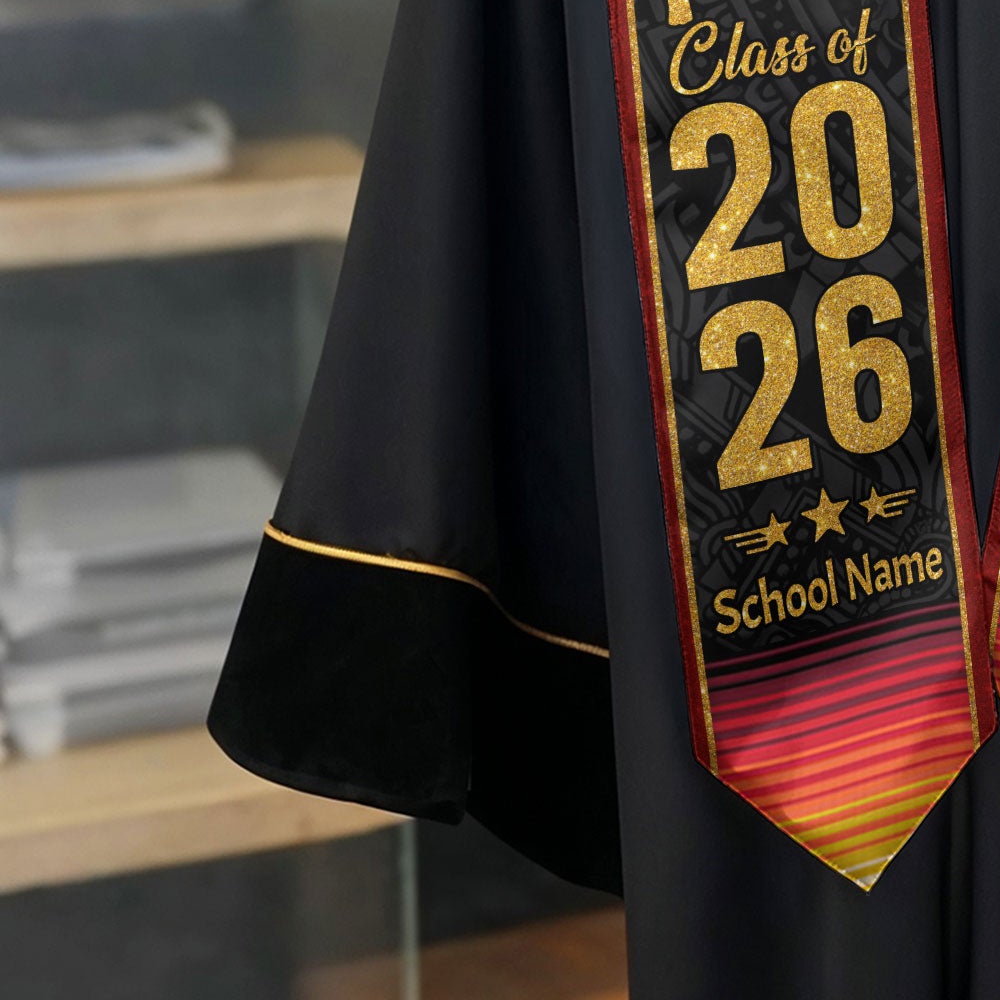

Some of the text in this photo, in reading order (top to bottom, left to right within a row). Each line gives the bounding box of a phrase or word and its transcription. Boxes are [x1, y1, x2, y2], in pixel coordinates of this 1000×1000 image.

[668, 7, 877, 96] Class of
[669, 79, 894, 291] 20
[699, 273, 913, 491] 26
[713, 546, 945, 635] School Name
